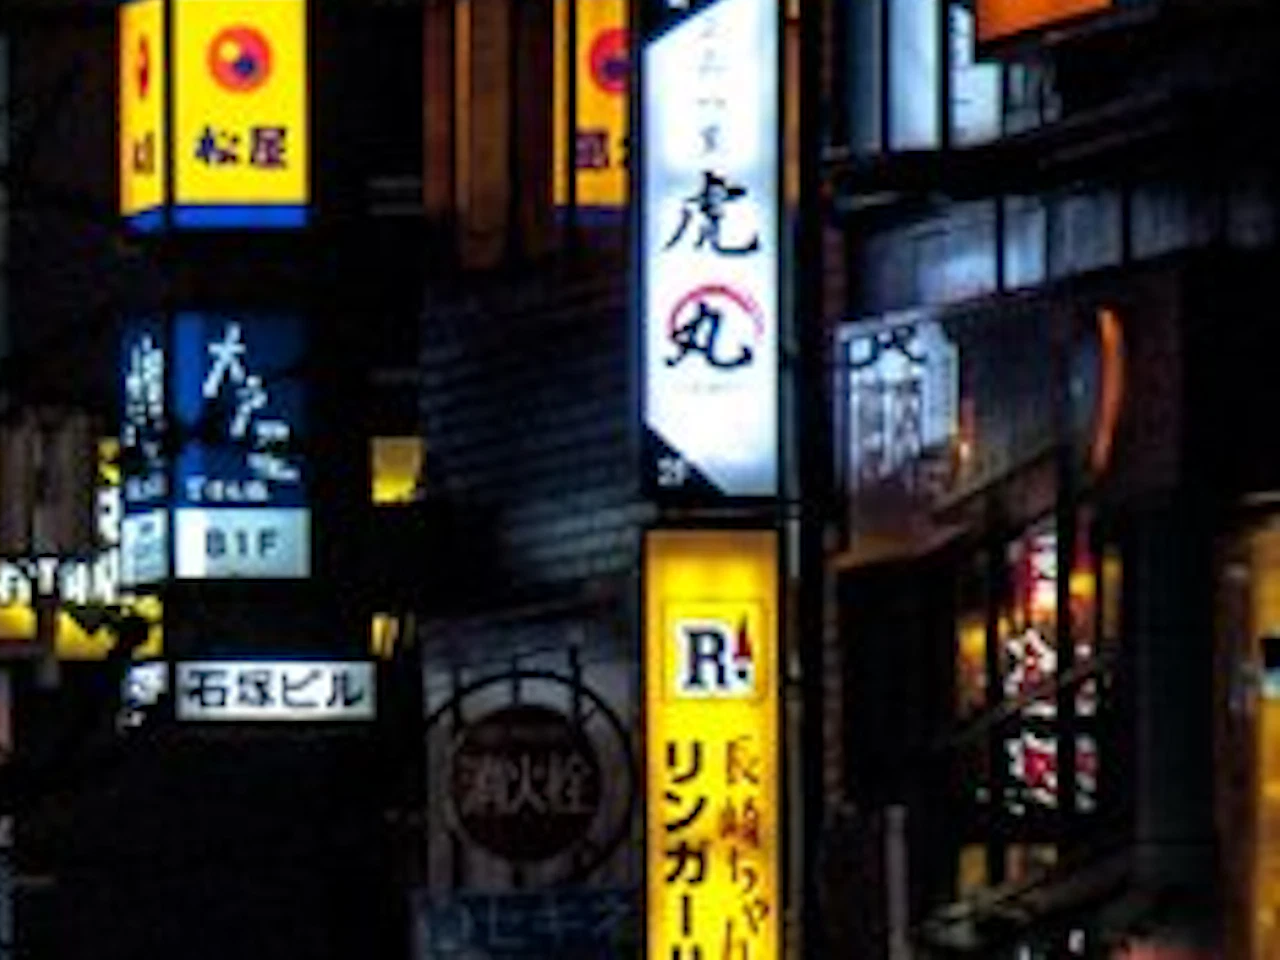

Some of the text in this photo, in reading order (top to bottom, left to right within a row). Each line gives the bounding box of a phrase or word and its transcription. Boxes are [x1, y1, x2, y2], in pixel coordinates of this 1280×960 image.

[194, 126, 288, 170] 松屋
[205, 528, 279, 559] B1F
[184, 668, 365, 708] 石塚ビル
[456, 746, 600, 816] 消火栓
